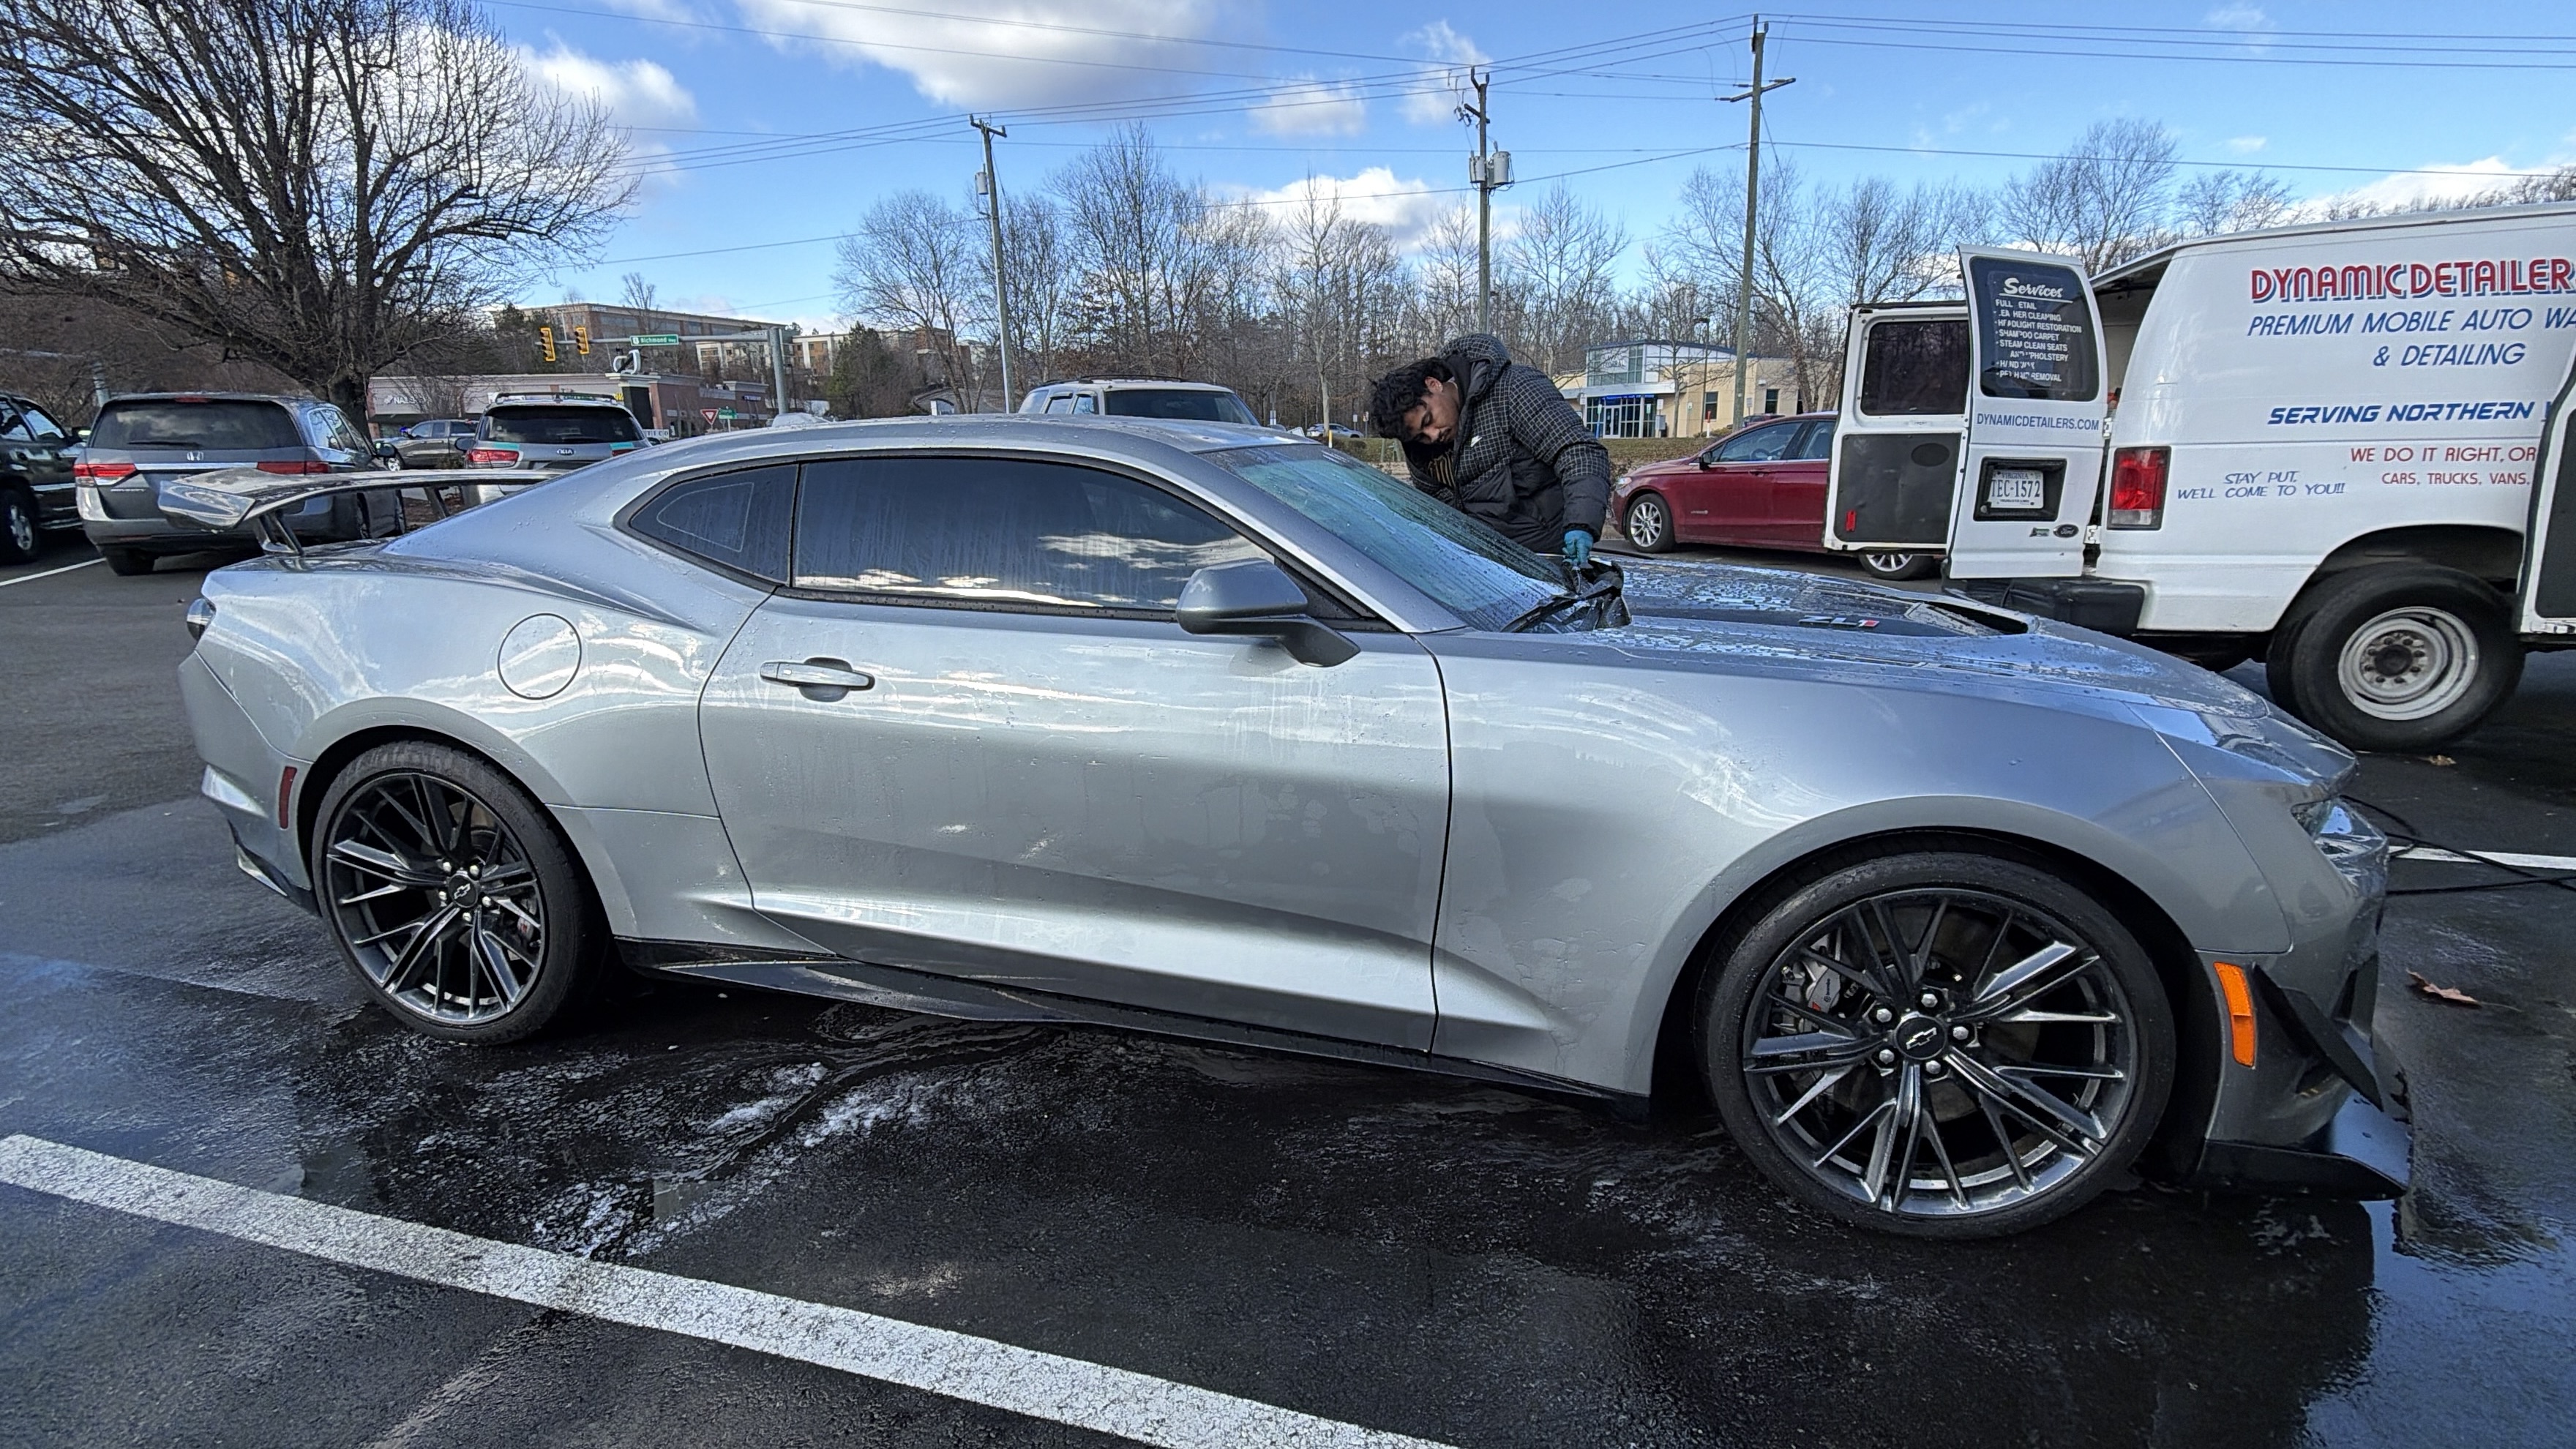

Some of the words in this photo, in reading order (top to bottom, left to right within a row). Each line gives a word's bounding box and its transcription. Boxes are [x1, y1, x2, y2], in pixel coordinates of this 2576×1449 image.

[2410, 258, 2576, 299] DETAILER
[2004, 277, 2063, 298] Services
[1996, 299, 2013, 307] FULL
[2037, 322, 2083, 333] RESTORATION
[2247, 313, 2354, 336] PREMIUM
[2361, 310, 2455, 333] MOBILE
[2460, 308, 2532, 330] AUTO
[2034, 333, 2060, 341] CARPET
[2023, 341, 2046, 350] CLEAN
[2047, 343, 2067, 351] SEATS
[2373, 346, 2390, 367] &
[2401, 342, 2526, 366] DETAILING
[2267, 405, 2382, 424] SERVING
[2386, 402, 2535, 422] NORTHERN
[1977, 413, 2100, 430] DYNAMICDETAILERS.COM
[2351, 448, 2375, 462] WE
[2384, 447, 2414, 462] DO
[2422, 448, 2438, 462] IT
[2508, 446, 2537, 462] OR
[2224, 471, 2262, 484] STAY
[2225, 486, 2268, 498] COME
[2277, 485, 2296, 496] TO
[2305, 483, 2345, 495] YOU!!
[1798, 615, 1880, 627] ZL1
